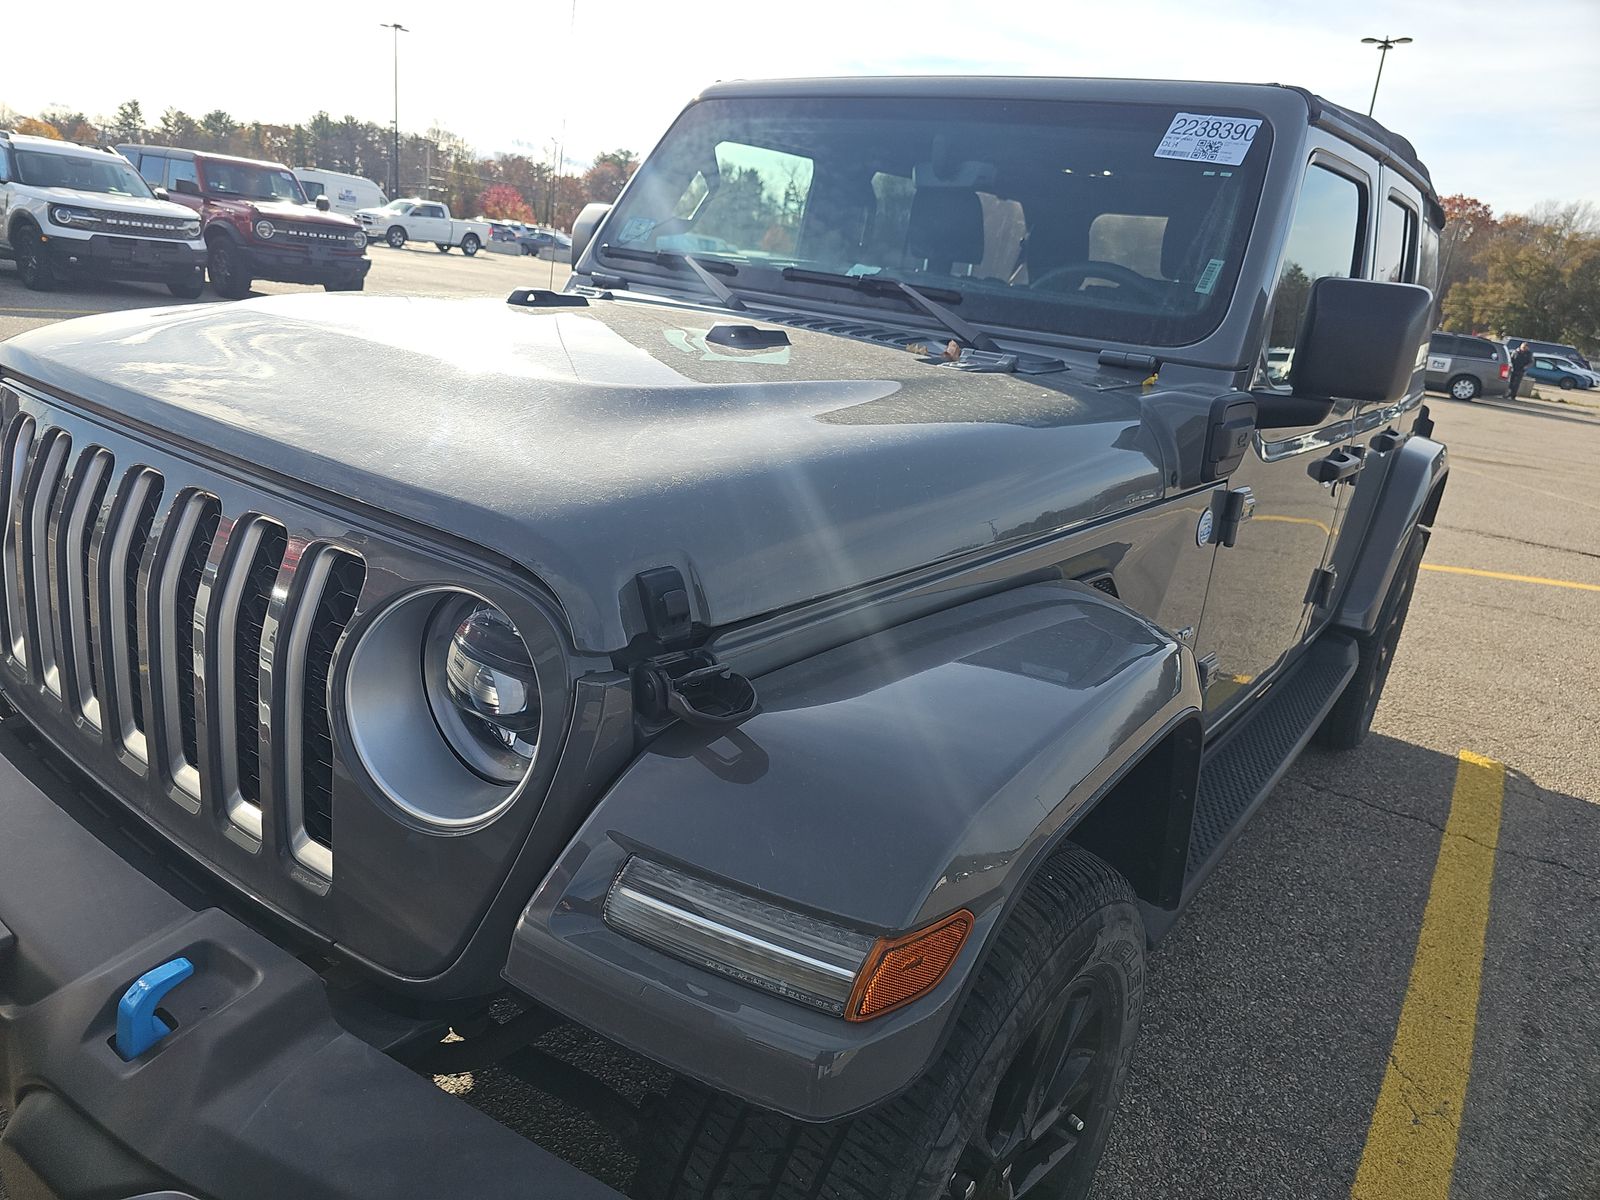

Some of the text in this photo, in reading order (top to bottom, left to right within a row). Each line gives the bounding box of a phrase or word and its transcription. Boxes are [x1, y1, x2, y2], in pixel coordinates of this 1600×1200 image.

[1170, 118, 1259, 142] 2238390
[106, 218, 175, 230] BRONCO
[288, 230, 346, 241] BRONCO
